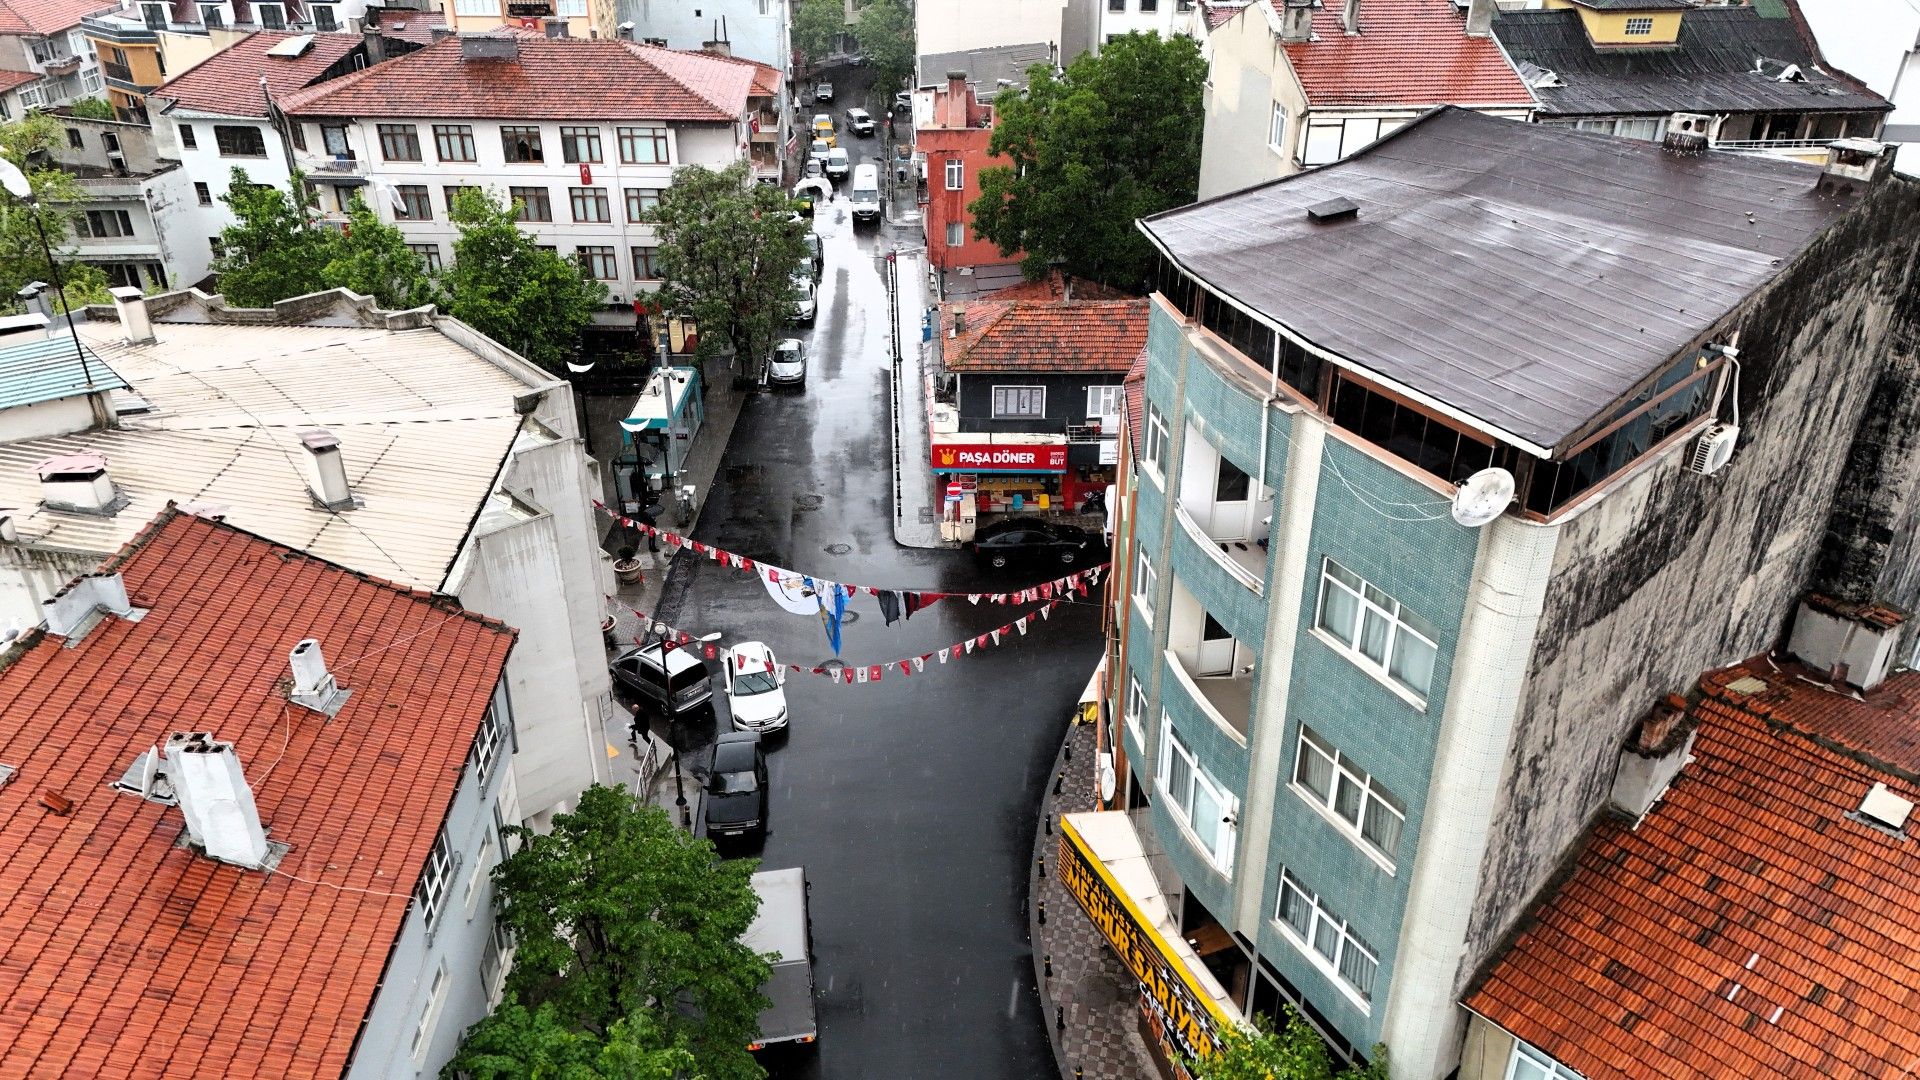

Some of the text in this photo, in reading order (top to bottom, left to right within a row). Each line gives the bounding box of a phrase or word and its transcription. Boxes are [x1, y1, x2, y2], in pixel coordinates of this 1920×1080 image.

[959, 452, 992, 466] PAŞA
[993, 449, 1035, 464] DÖNER
[1049, 458, 1065, 466] BUT
[1070, 851, 1138, 946] SERKAN USTA
[1133, 948, 1212, 1063] SARIYER
[1140, 981, 1164, 1020] CAFE
